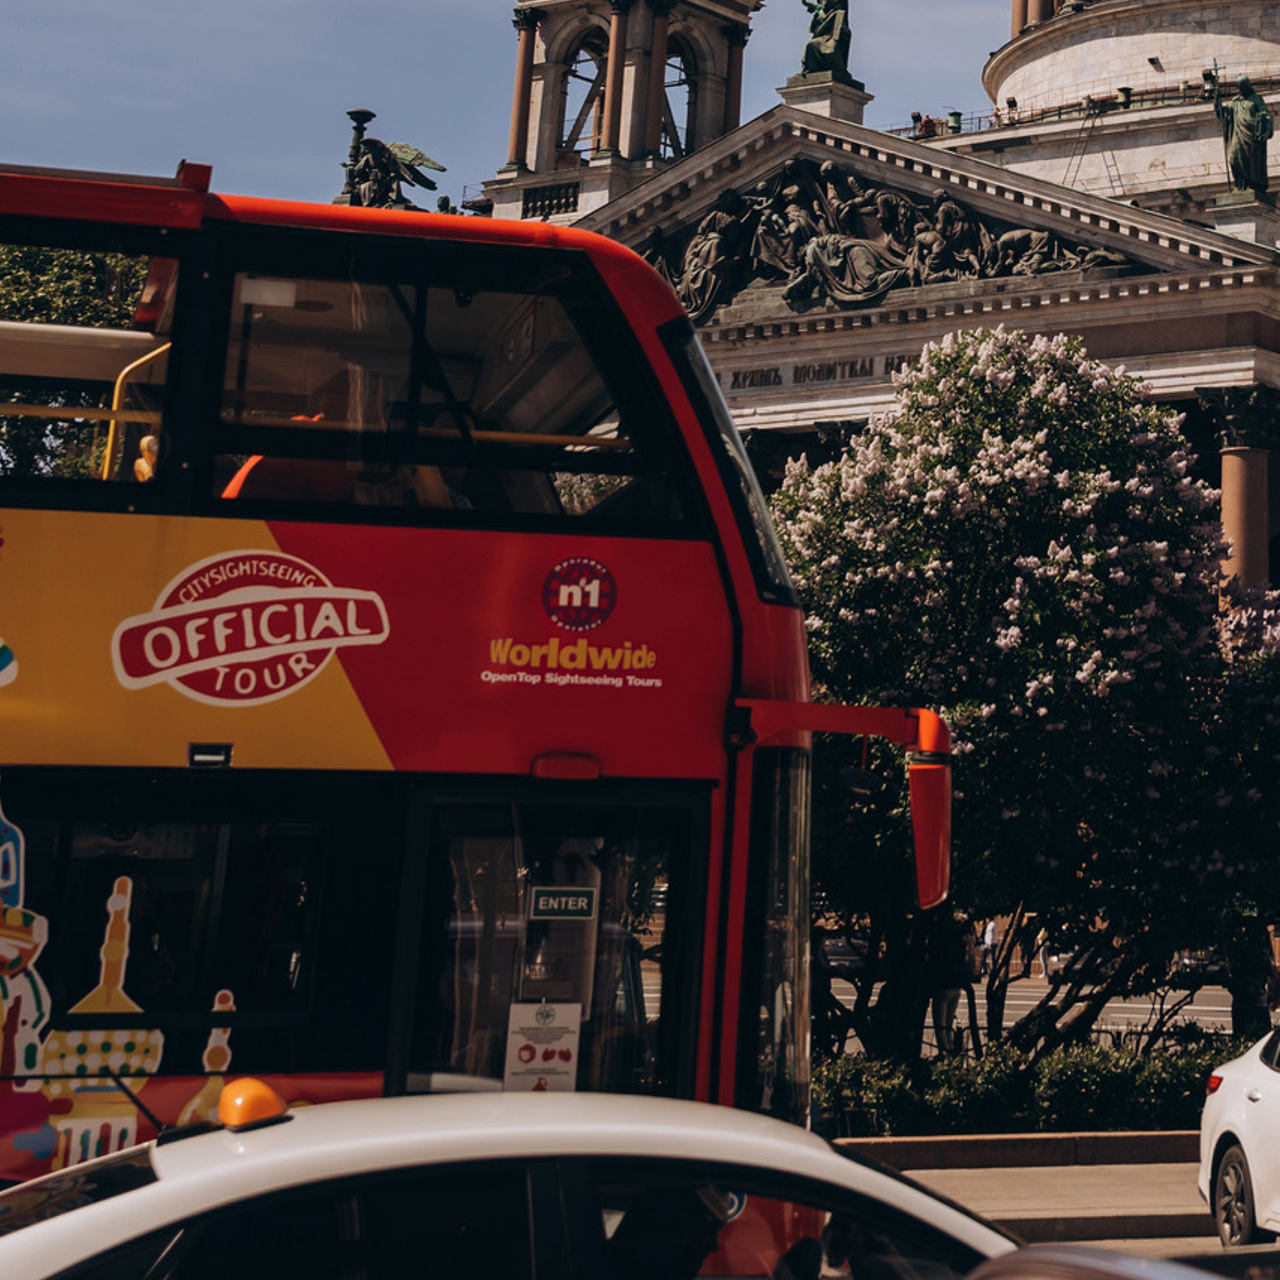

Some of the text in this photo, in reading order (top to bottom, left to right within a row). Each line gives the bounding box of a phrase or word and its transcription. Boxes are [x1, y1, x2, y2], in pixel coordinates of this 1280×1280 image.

[179, 560, 317, 604] CITYSIGHTSEEING
[143, 600, 371, 669] OFFICIAL
[490, 637, 657, 670] Worldwide
[213, 652, 317, 694] TOUR
[545, 672, 623, 688] Sightseeing
[626, 675, 662, 687] Tours
[538, 896, 589, 911] ENTER
